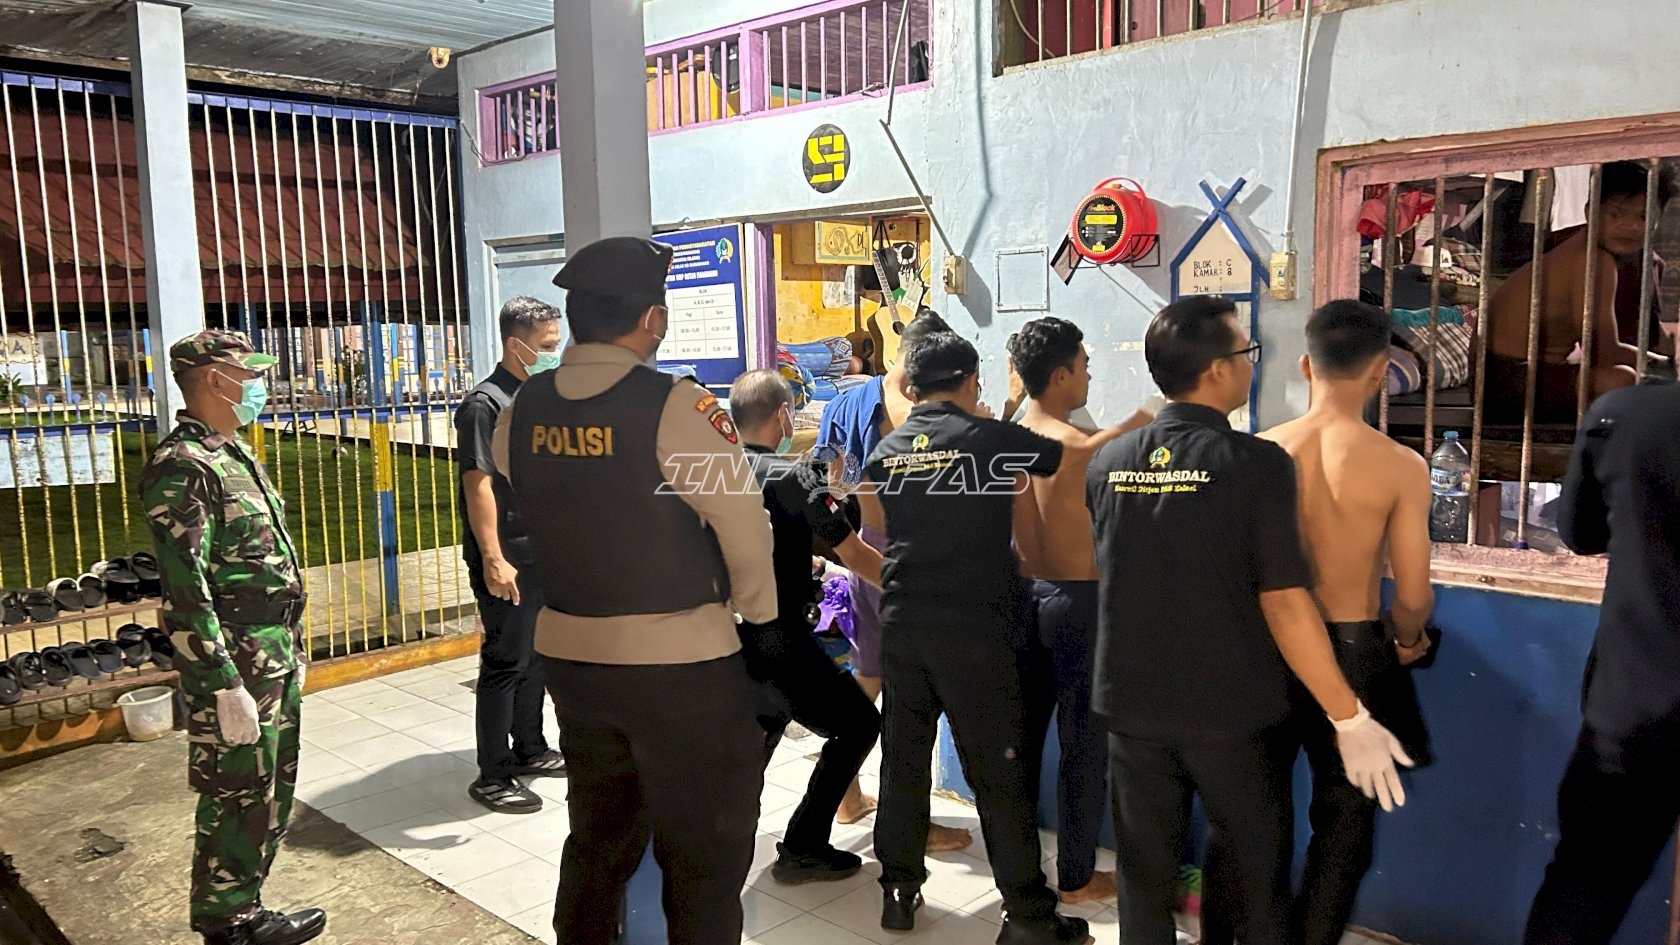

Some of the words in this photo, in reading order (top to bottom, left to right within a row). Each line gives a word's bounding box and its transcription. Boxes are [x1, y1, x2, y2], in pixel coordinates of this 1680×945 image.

[1193, 260, 1212, 270] BLOK
[1226, 258, 1232, 267] C
[1193, 268, 1218, 278] KAMAR
[1227, 267, 1233, 276] 8
[1193, 285, 1209, 293] JLH
[531, 425, 613, 457] POLISI
[1108, 470, 1210, 483] BINTORWASDAL
